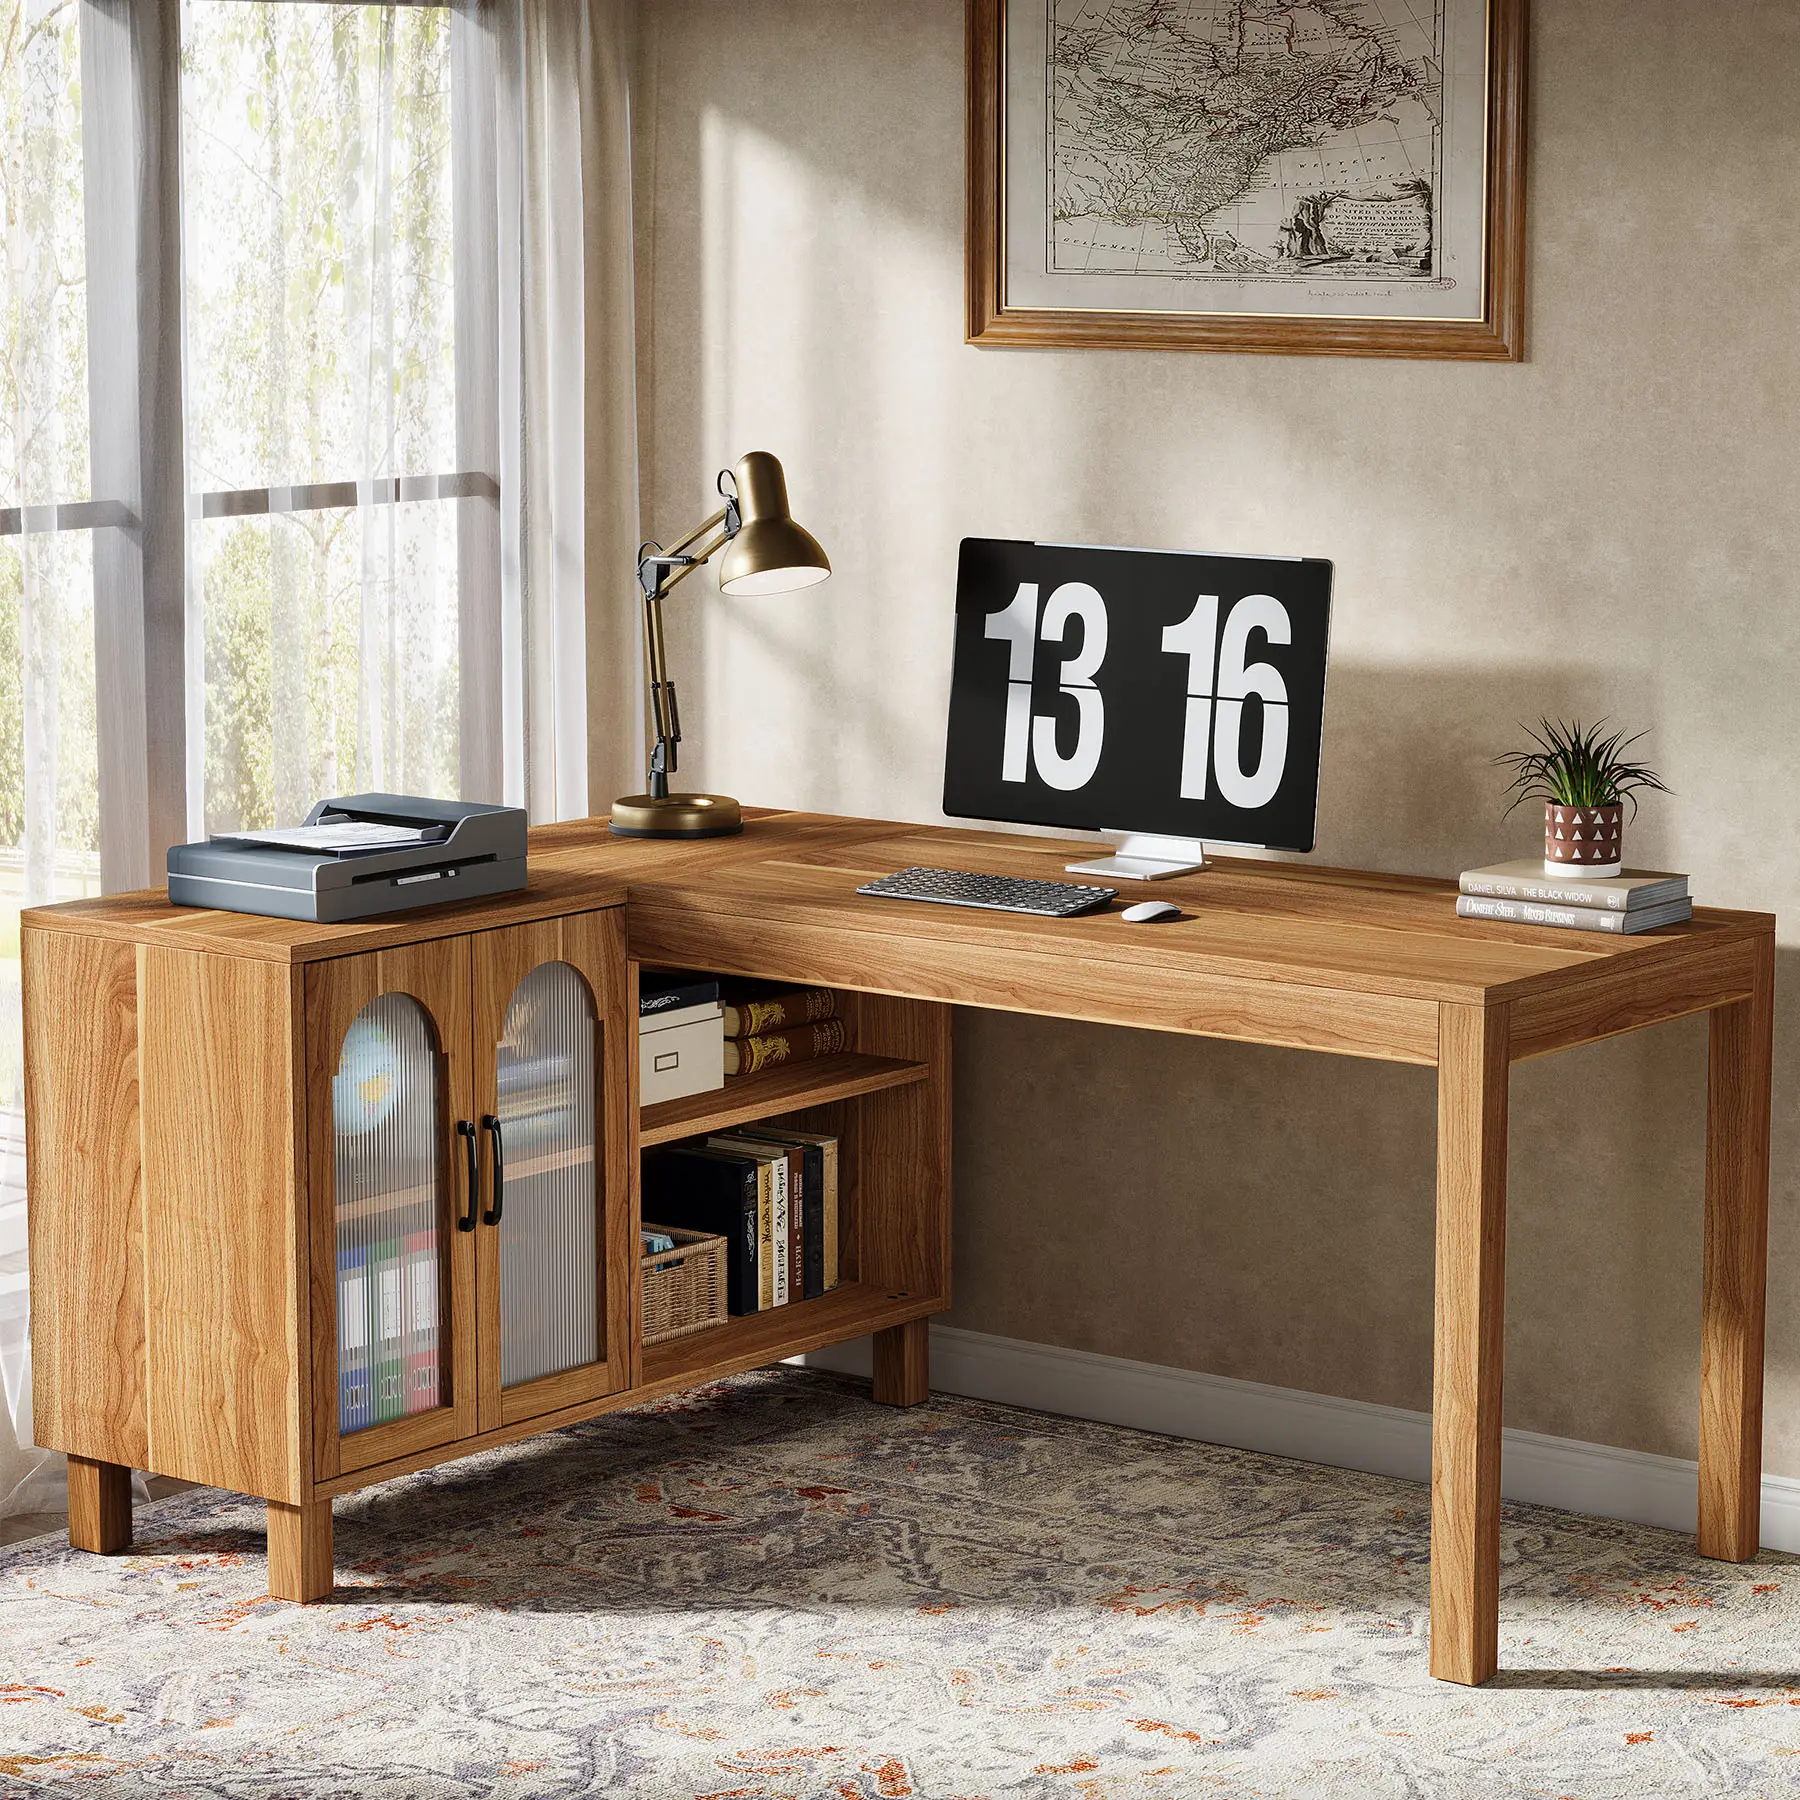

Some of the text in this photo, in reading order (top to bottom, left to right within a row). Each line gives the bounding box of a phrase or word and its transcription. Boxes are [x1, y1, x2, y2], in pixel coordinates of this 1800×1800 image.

[984, 581, 1292, 809] 13 16
[1468, 883, 1495, 894] DANIEL
[1496, 883, 1517, 896] SILVA
[1522, 887, 1536, 898] THE
[1538, 888, 1563, 900] BLACK
[1563, 890, 1593, 904] WIDOW
[1495, 902, 1517, 918] STEEL
[761, 1170, 772, 1243] Жажда жизни
